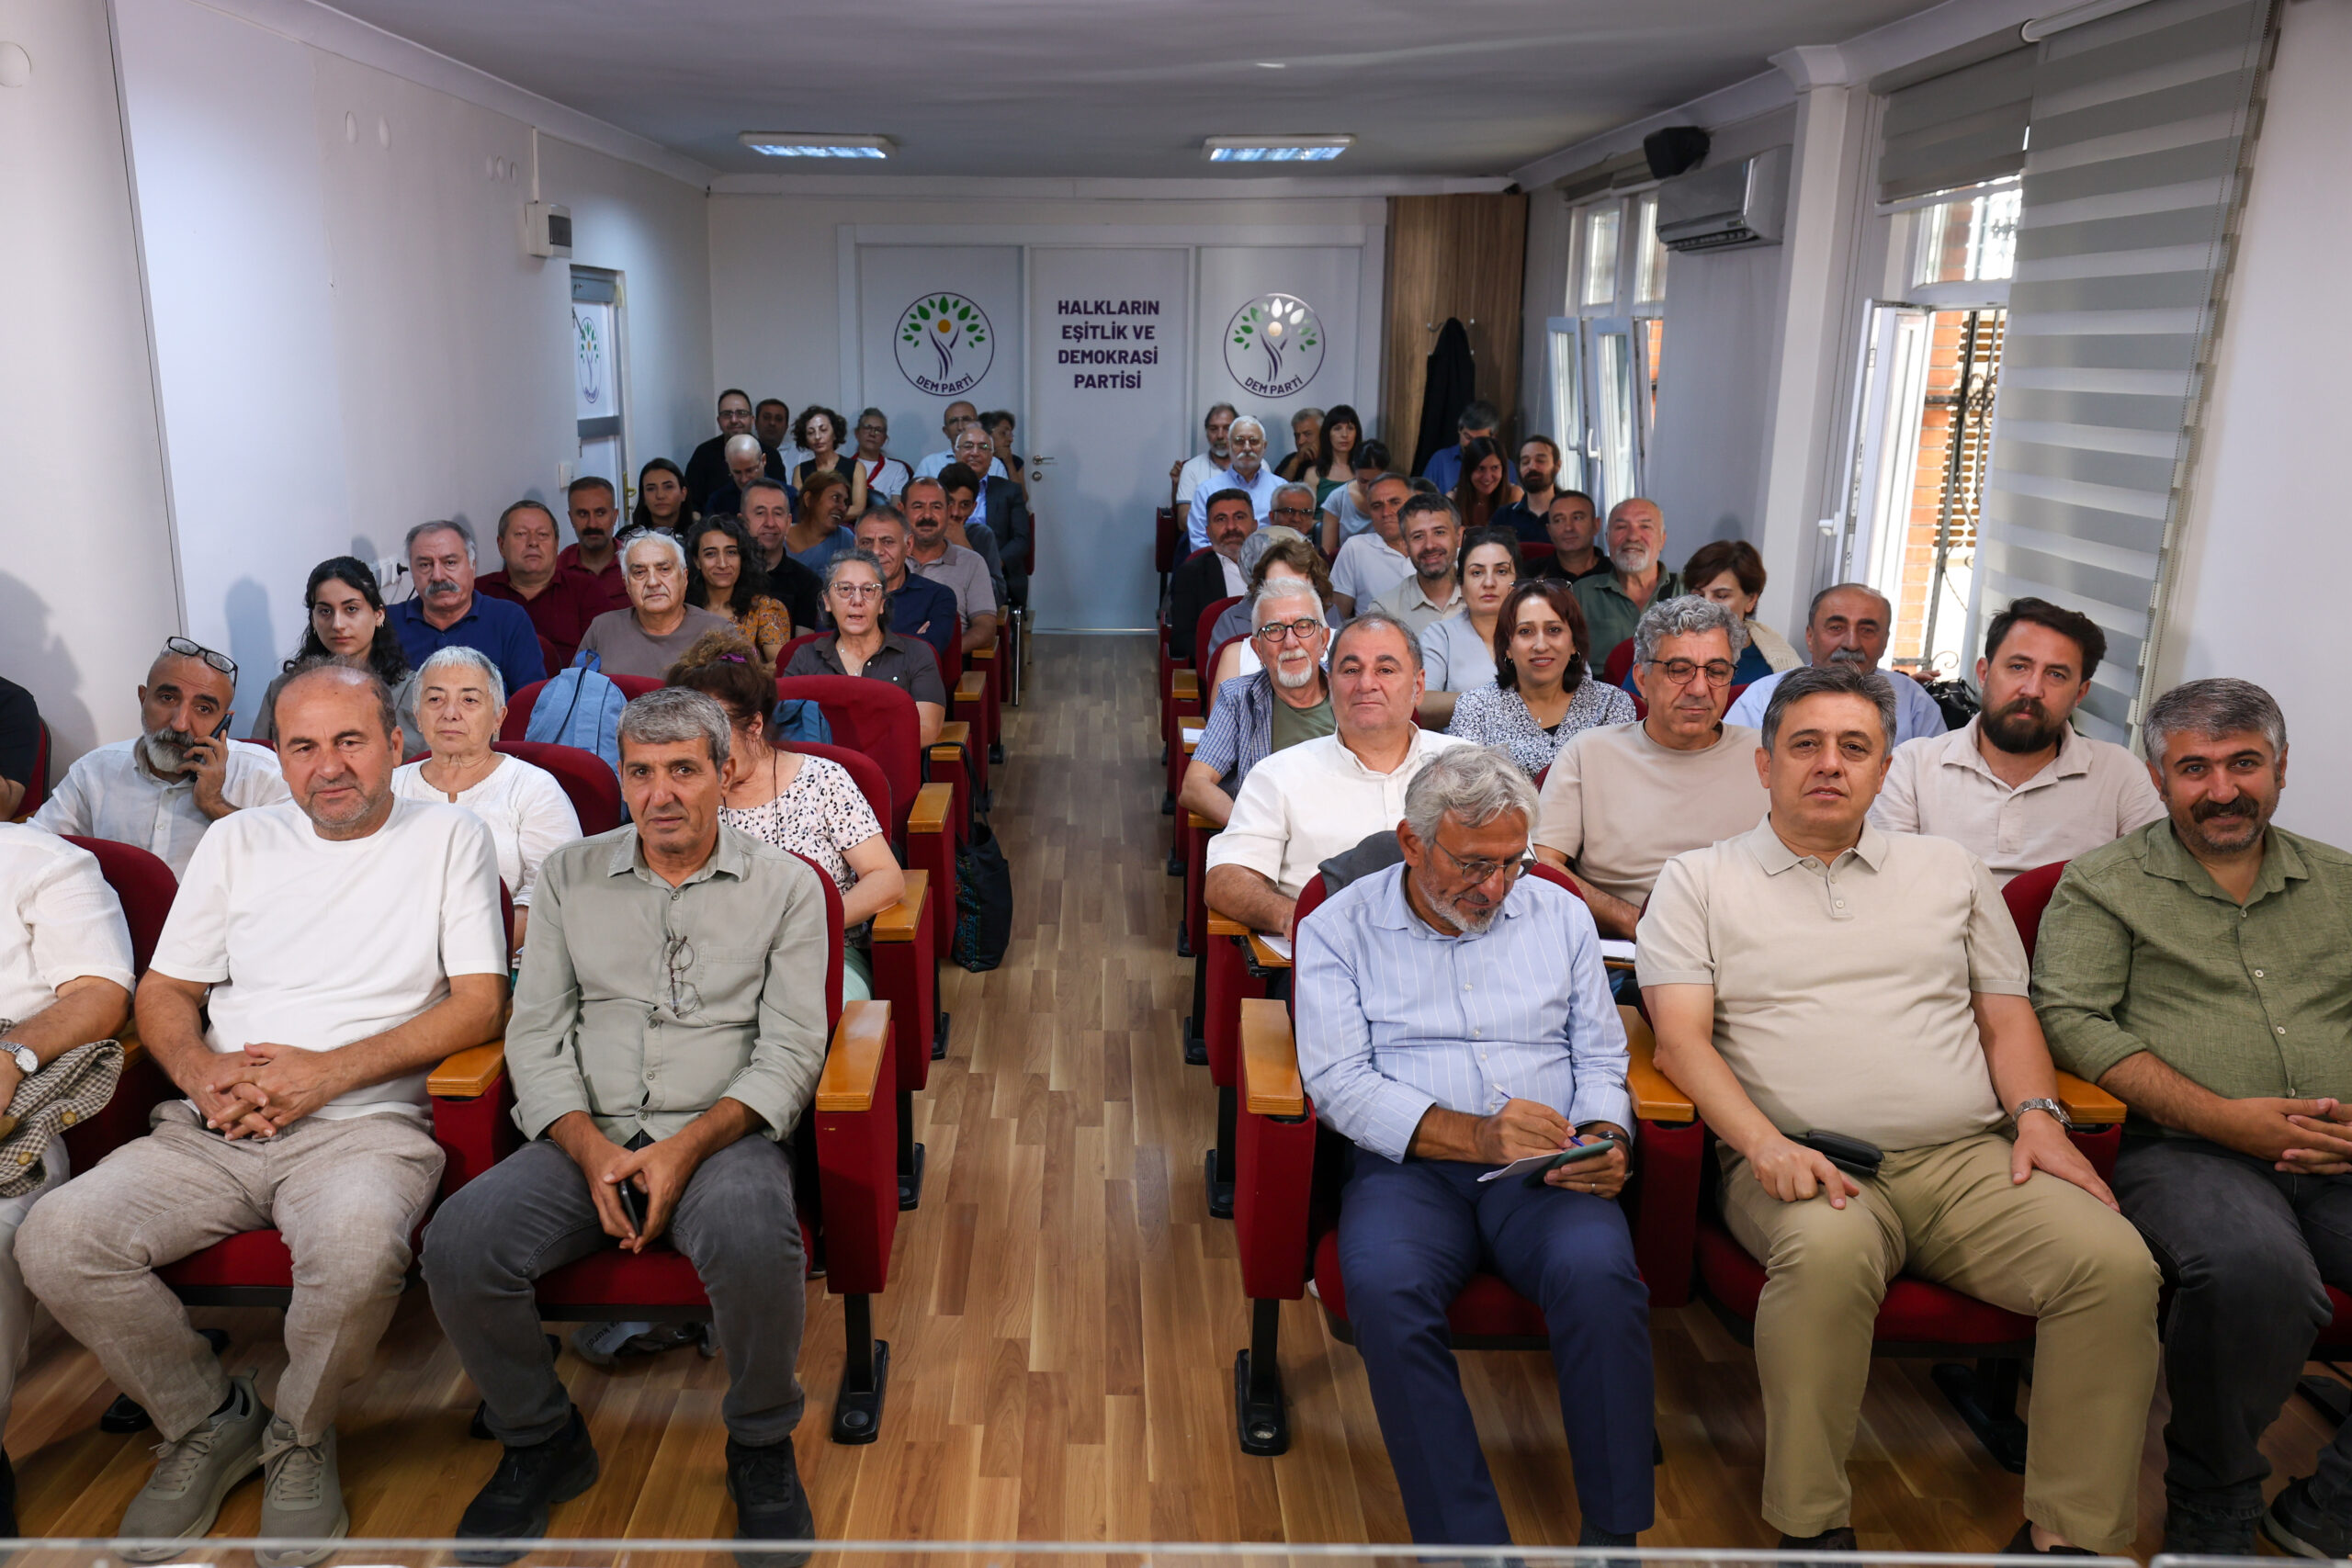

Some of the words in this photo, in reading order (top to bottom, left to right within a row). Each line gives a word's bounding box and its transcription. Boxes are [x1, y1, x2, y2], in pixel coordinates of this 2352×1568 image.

[1057, 299, 1159, 315] HALKLARIN
[1062, 321, 1128, 343] EŞİTLİK
[1132, 325, 1156, 340] VE
[1057, 345, 1159, 365] DEMOKRASİ
[916, 375, 939, 392] DEM
[941, 372, 974, 393] PARTİ
[1074, 369, 1141, 389] PARTİSİ
[1244, 377, 1268, 394] DEM
[1270, 374, 1303, 394] PARTİ
